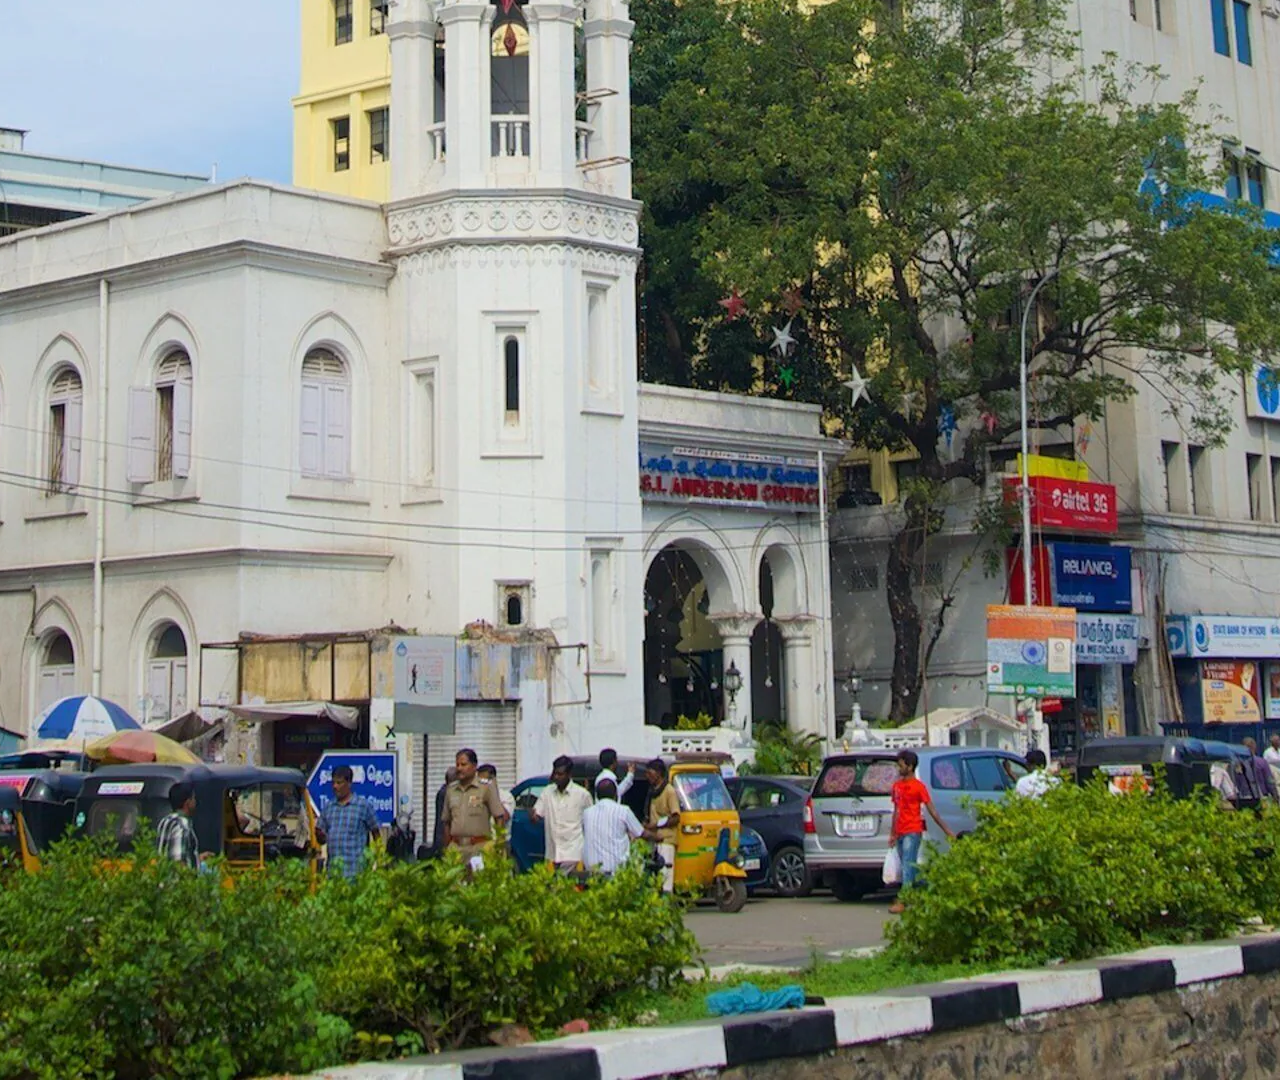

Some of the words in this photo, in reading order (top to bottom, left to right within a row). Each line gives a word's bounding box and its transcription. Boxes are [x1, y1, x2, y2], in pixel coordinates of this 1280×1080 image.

[672, 477, 757, 500] ANDERSON
[1062, 488, 1090, 512] airtel
[1093, 493, 1109, 513] 3G
[1087, 645, 1125, 654] MEDICALS
[367, 764, 393, 787] தெரு
[367, 794, 393, 812] Street
